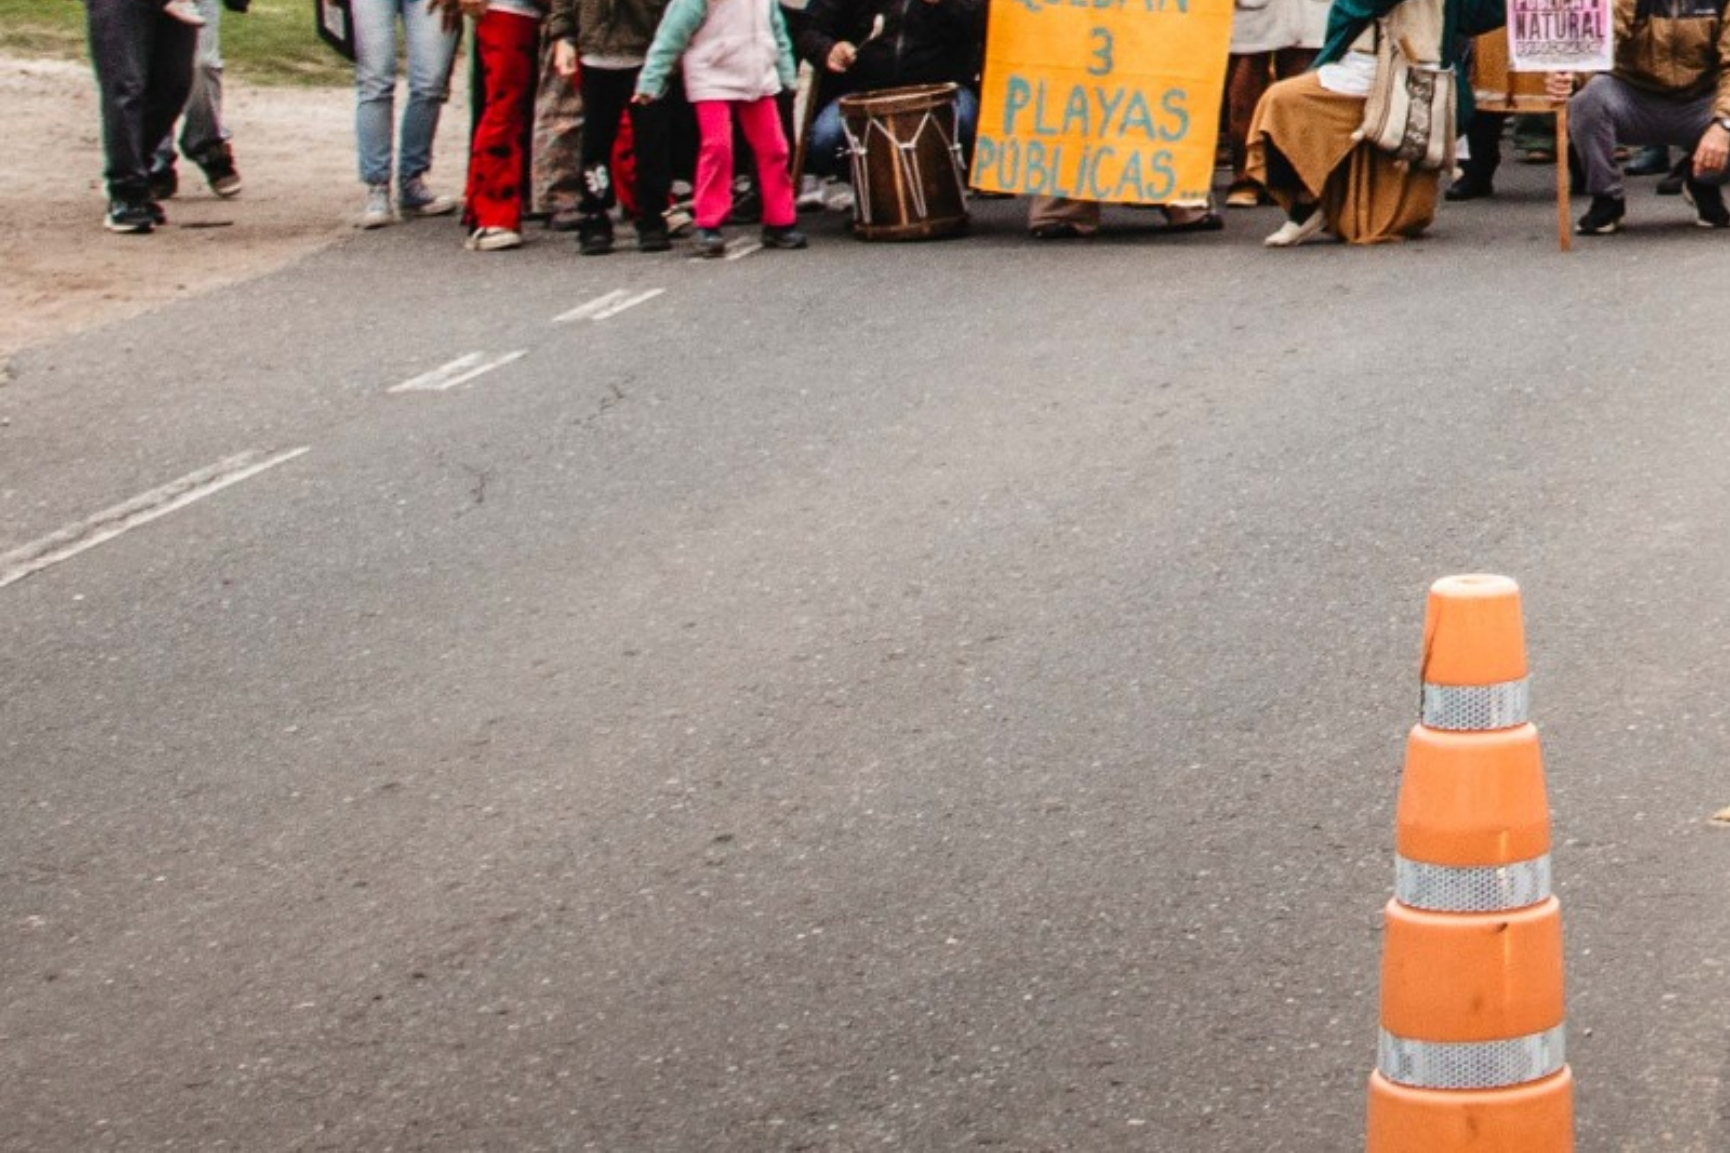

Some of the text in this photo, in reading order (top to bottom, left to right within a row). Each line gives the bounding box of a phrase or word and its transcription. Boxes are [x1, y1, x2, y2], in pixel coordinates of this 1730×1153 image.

[1515, 11, 1605, 40] NATURAL
[1086, 26, 1115, 77] 3
[1002, 74, 1191, 142] PLAYAS
